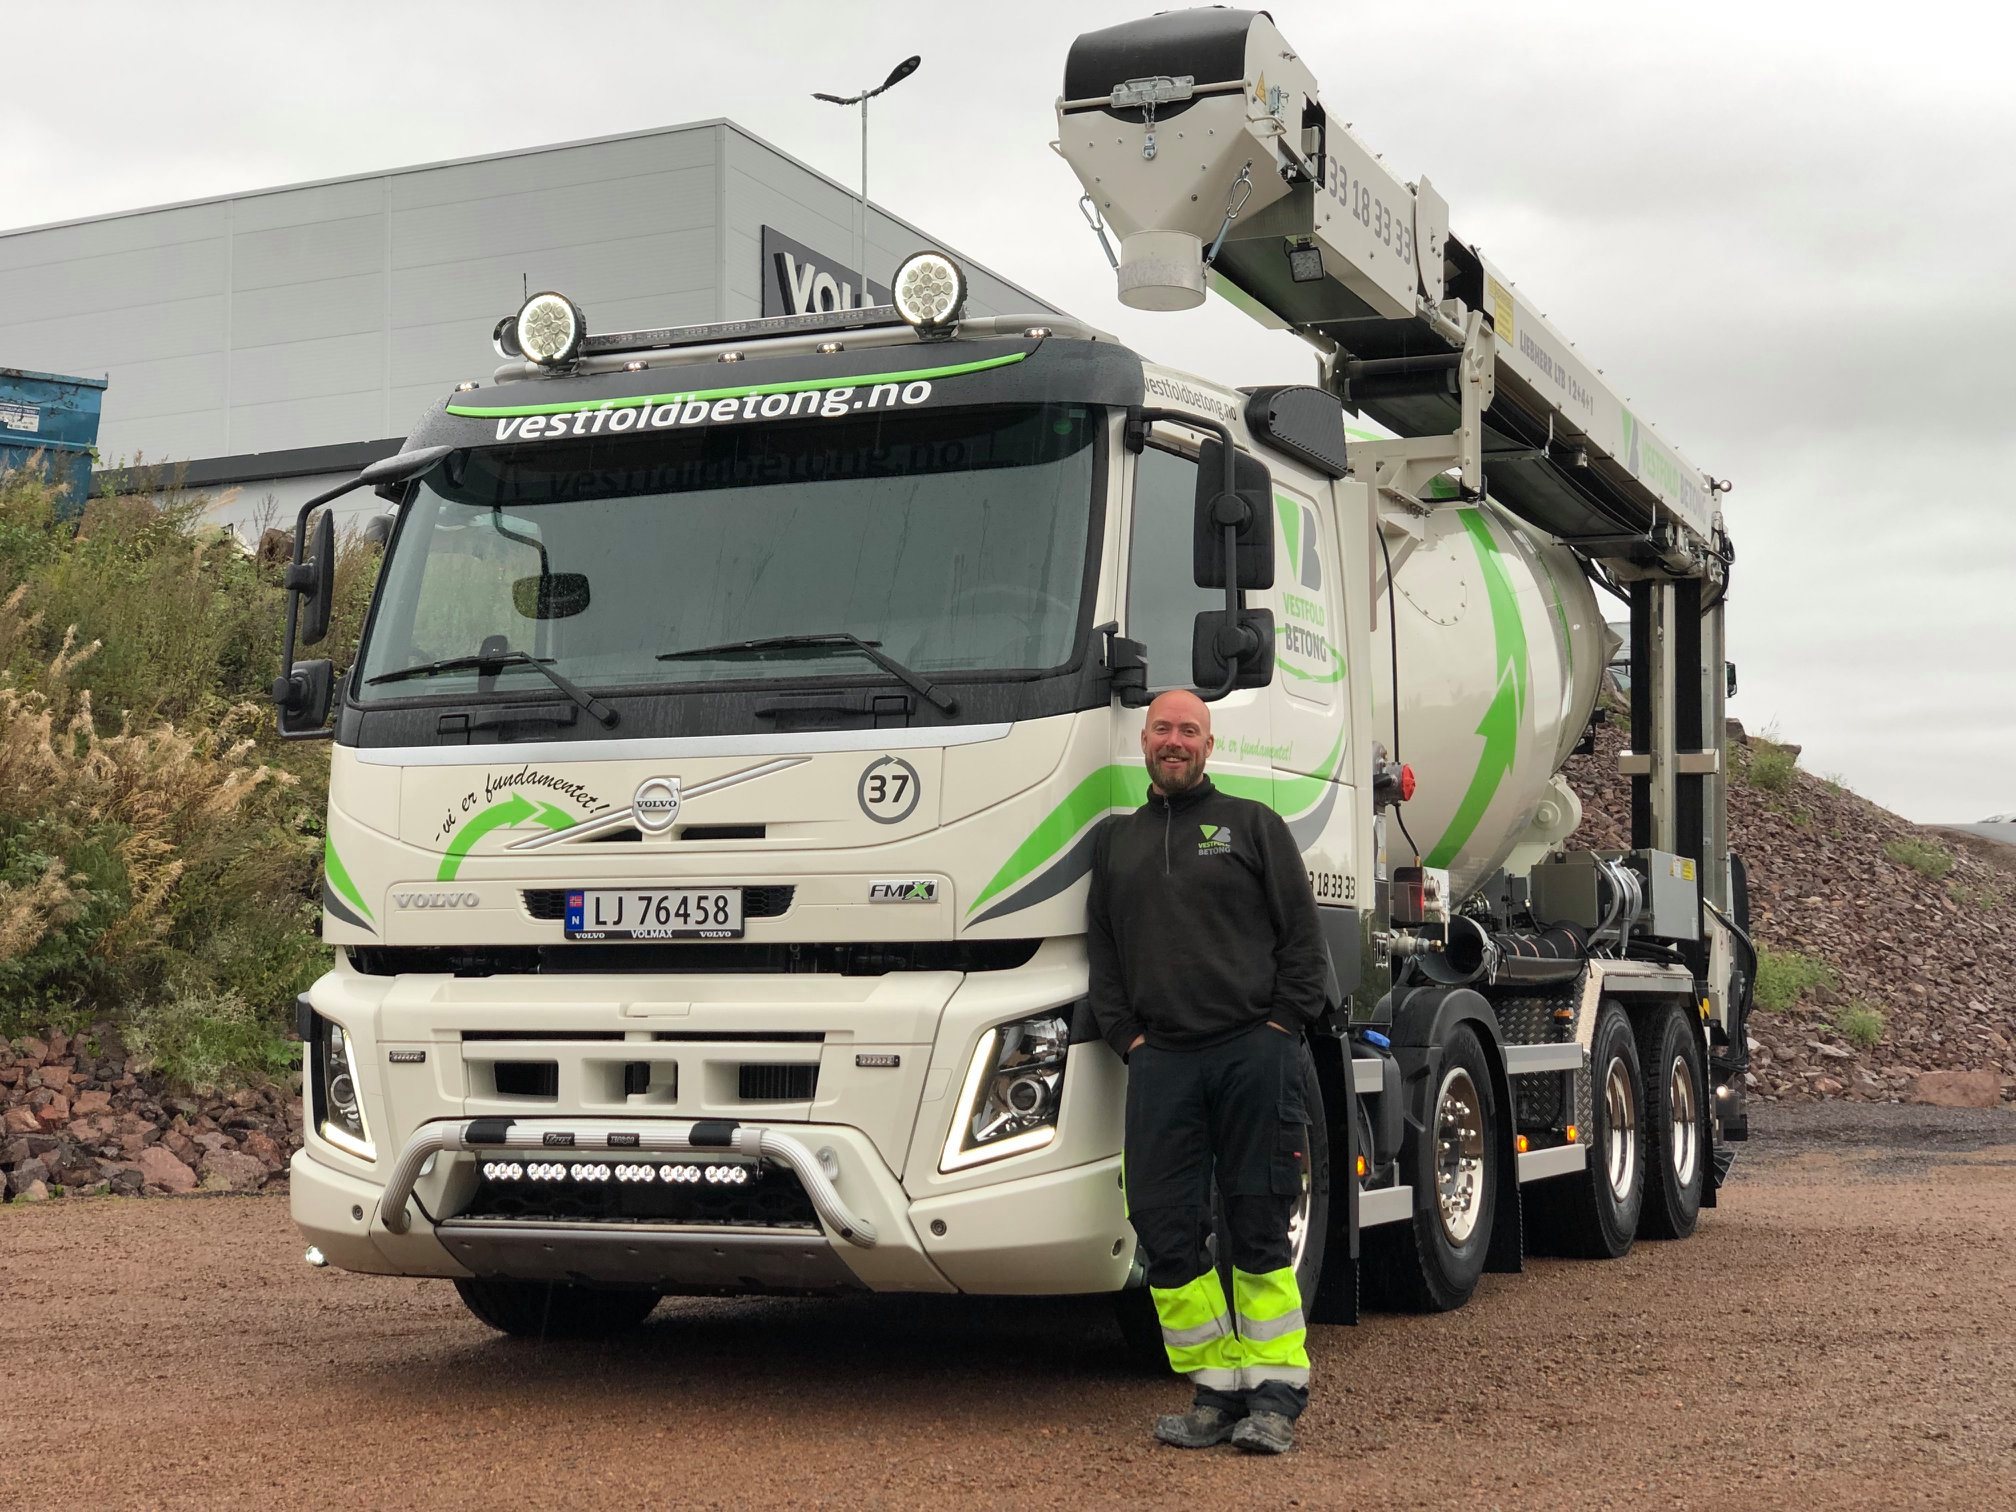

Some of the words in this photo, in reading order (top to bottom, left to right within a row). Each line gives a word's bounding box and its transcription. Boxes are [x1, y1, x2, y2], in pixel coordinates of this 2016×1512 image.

[1329, 156, 1347, 207] 33
[1352, 180, 1370, 228] 18
[1374, 198, 1391, 247] 33
[1395, 218, 1411, 265] 33
[1519, 329, 1553, 380] LIEBHERR
[1554, 361, 1566, 390] LTB
[494, 380, 932, 440] vestfoldbetong.no
[1144, 377, 1237, 421] vestfoldbetong.no
[1282, 591, 1325, 628] VESTFOLD
[1285, 622, 1328, 662] BETONG
[461, 792, 478, 812] er
[485, 764, 610, 815] fundamentet!
[636, 800, 678, 808] VOLVO
[868, 774, 910, 804] 37
[1198, 846, 1231, 856] BETONG
[392, 892, 480, 908] VOLVO
[869, 881, 933, 900] FMX
[1317, 872, 1329, 897] 18
[1331, 873, 1343, 899] 33
[1345, 875, 1356, 900] 33
[571, 915, 580, 925] N
[594, 896, 624, 926] LJ
[637, 894, 730, 926] 76458
[574, 932, 606, 940] VOLVO
[630, 929, 674, 939] VOLMAX
